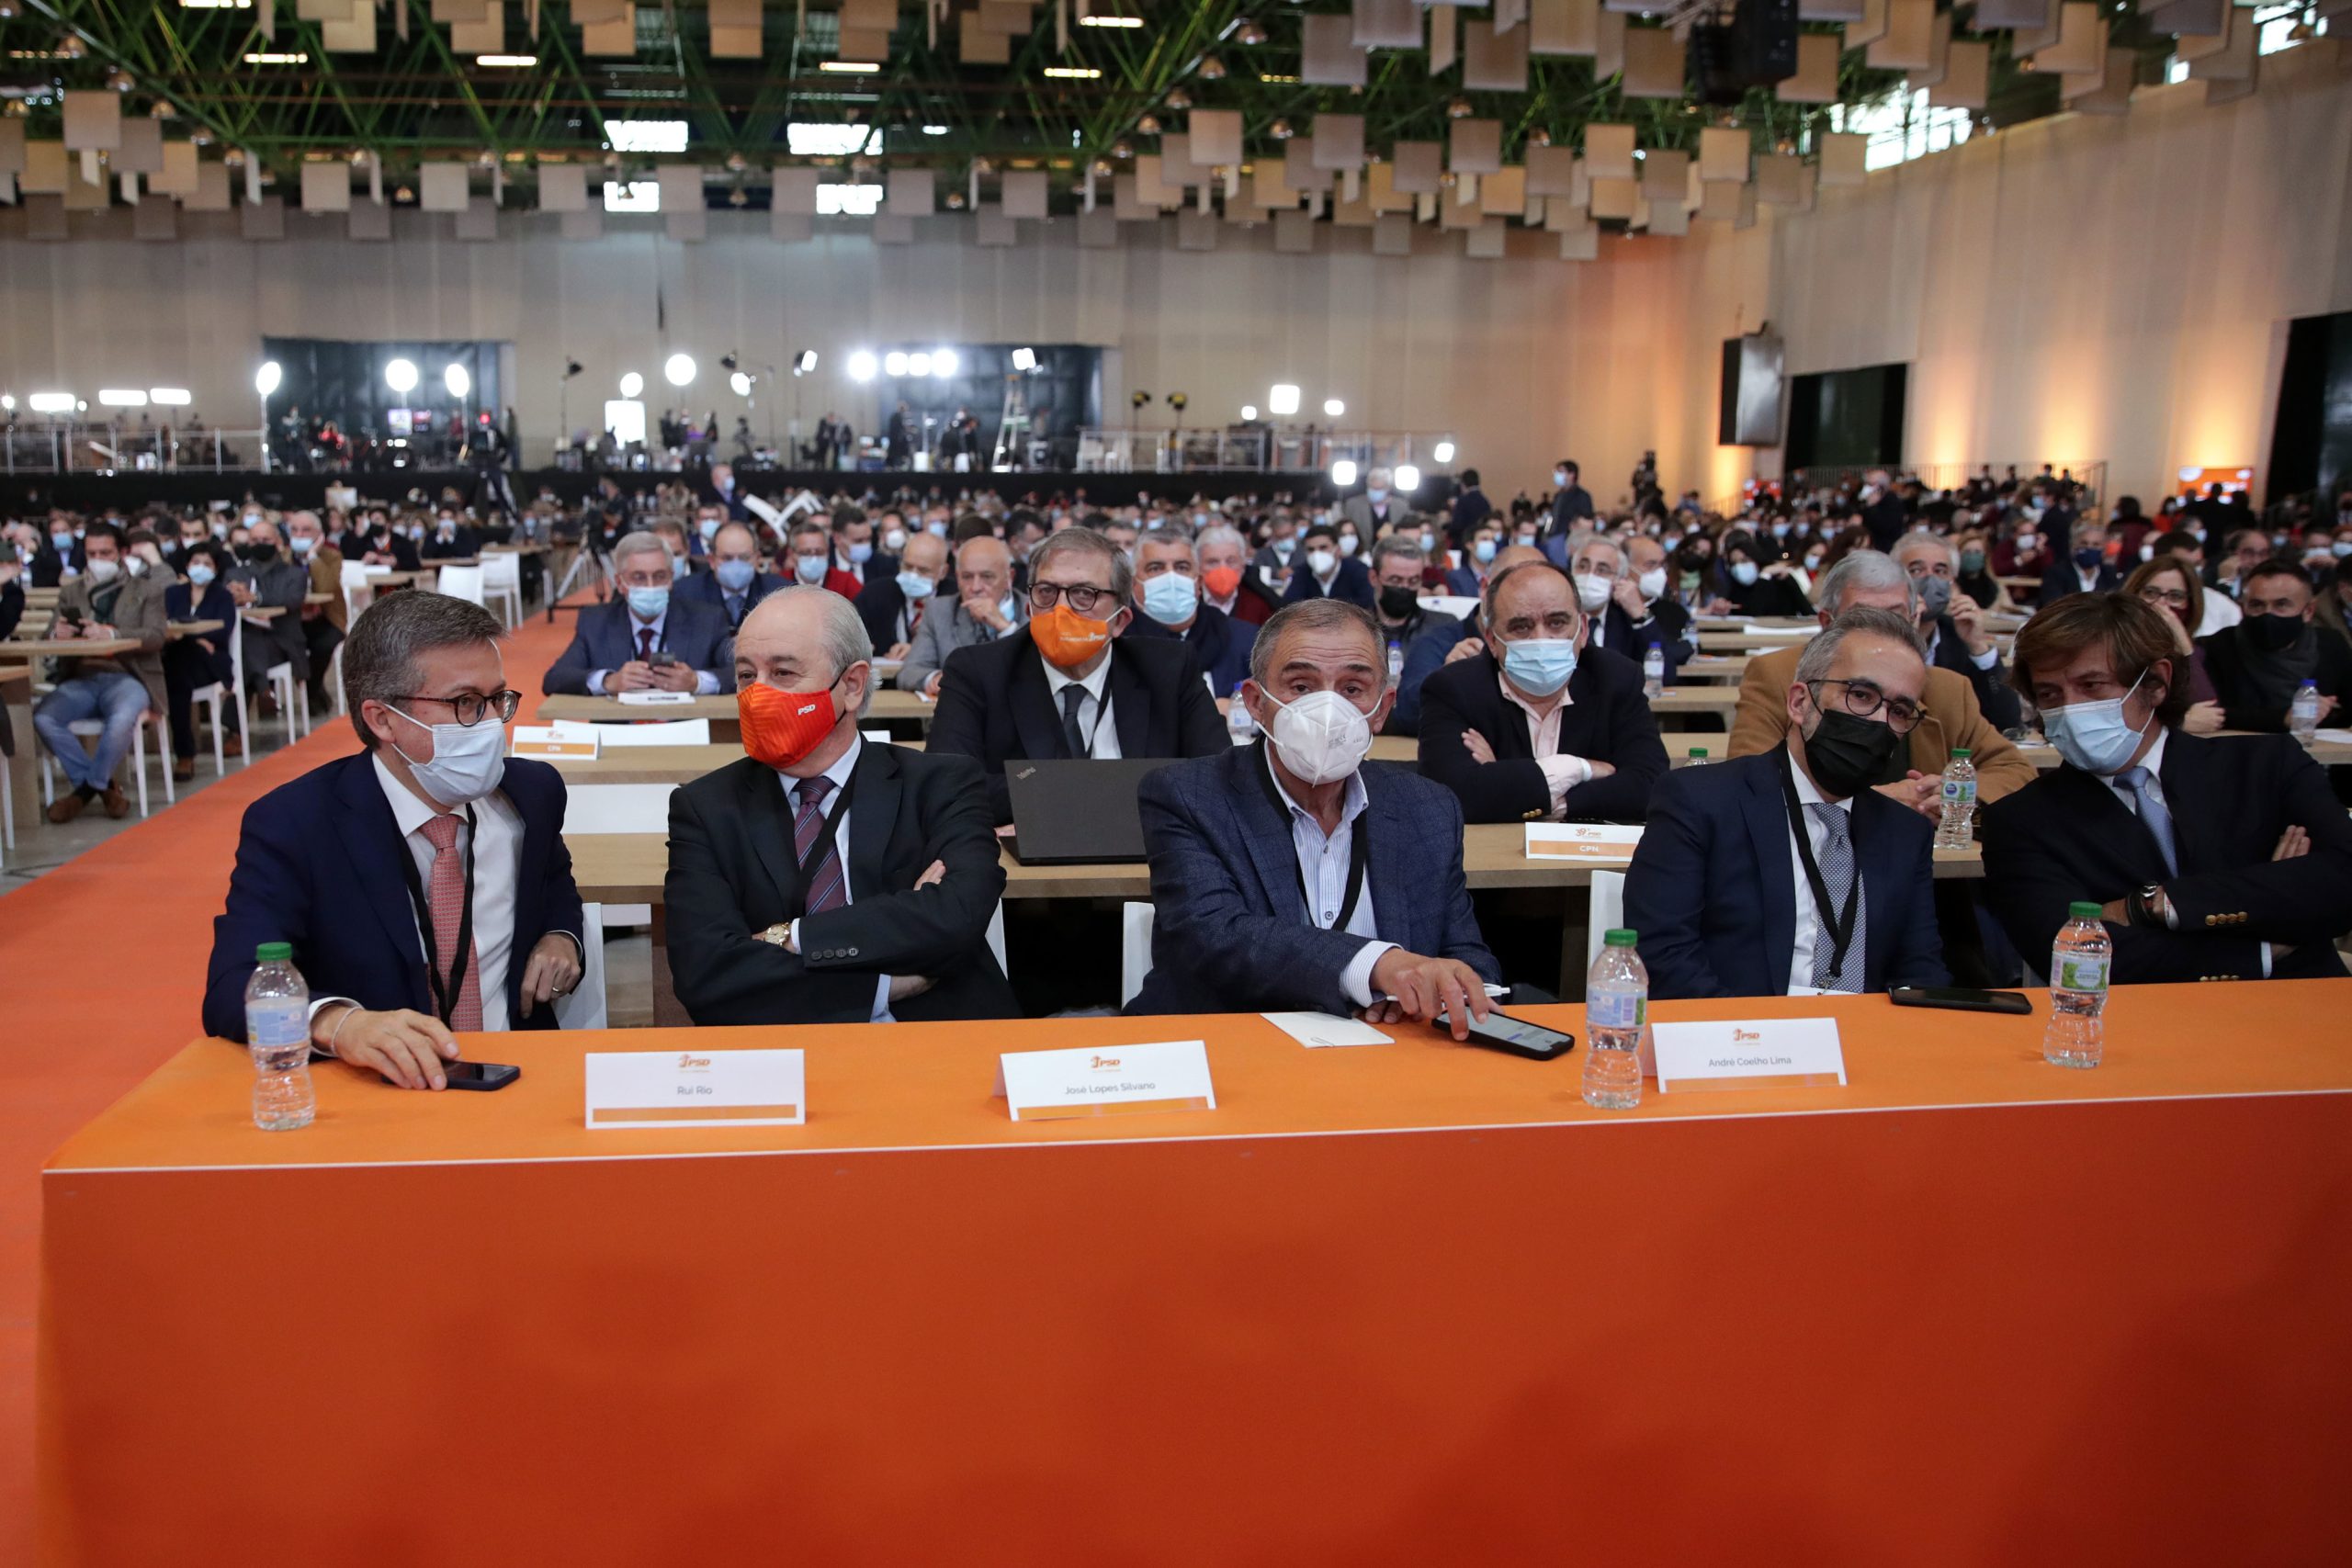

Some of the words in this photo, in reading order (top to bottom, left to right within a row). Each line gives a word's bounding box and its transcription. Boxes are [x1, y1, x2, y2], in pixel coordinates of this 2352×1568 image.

[797, 705, 816, 715] PSD
[1736, 1056, 1769, 1066] Coelho
[1770, 1056, 1792, 1065] Lima
[677, 1086, 694, 1095] Rui
[696, 1086, 713, 1095] Rio
[1090, 1084, 1118, 1095] Lopes
[1121, 1082, 1156, 1091] Silvano
